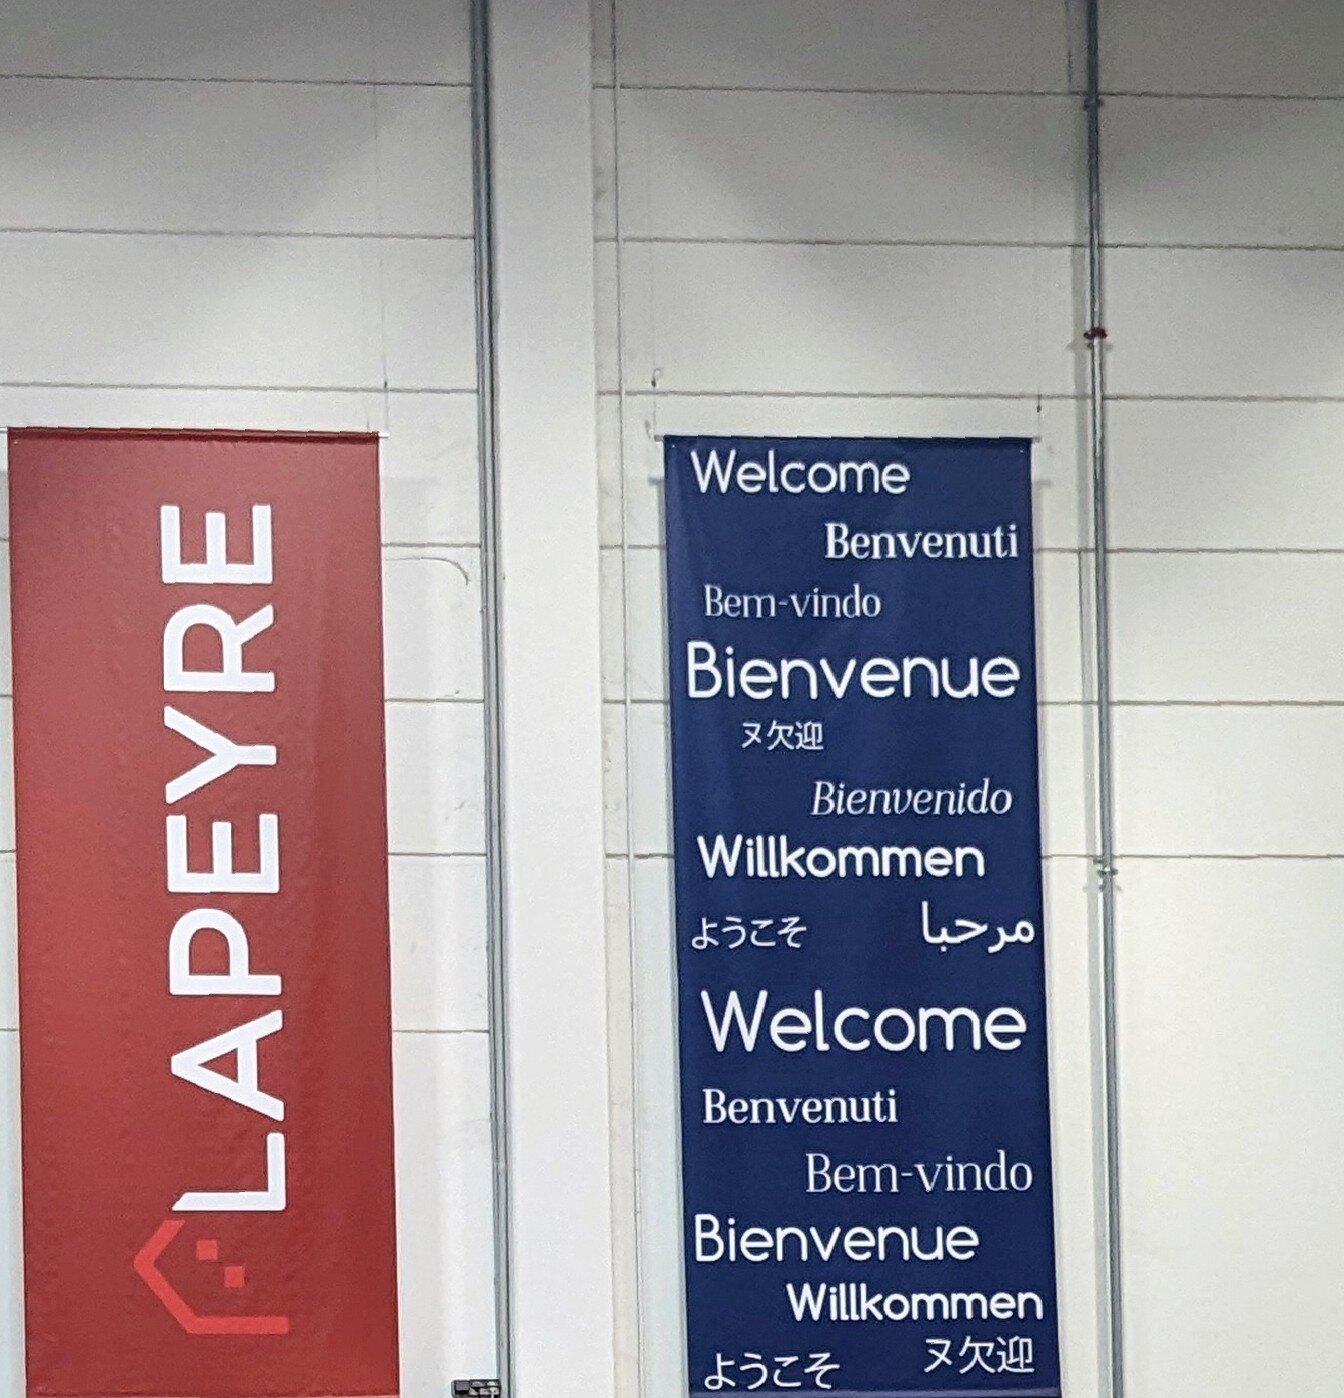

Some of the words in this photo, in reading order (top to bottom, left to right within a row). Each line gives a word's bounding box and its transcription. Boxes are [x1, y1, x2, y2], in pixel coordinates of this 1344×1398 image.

[691, 449, 910, 494] Welcome
[825, 523, 1017, 559] Benvenuti
[705, 584, 880, 618] Bem-vindo
[688, 641, 1020, 699] Bienvenue
[812, 778, 1012, 815] Bienvenido
[160, 503, 286, 1211] LAPEYRE
[697, 834, 984, 878] Willkommen
[692, 917, 806, 949] ようこそ
[922, 901, 1034, 953] مرحبا
[701, 990, 1026, 1052] Welcome
[703, 1089, 897, 1123] Benvenuti
[806, 1150, 1032, 1192] Bem-vindo
[695, 1214, 979, 1261] Bienvenue
[786, 1283, 1043, 1321] Willkommen
[705, 1353, 840, 1389] ようこそ
